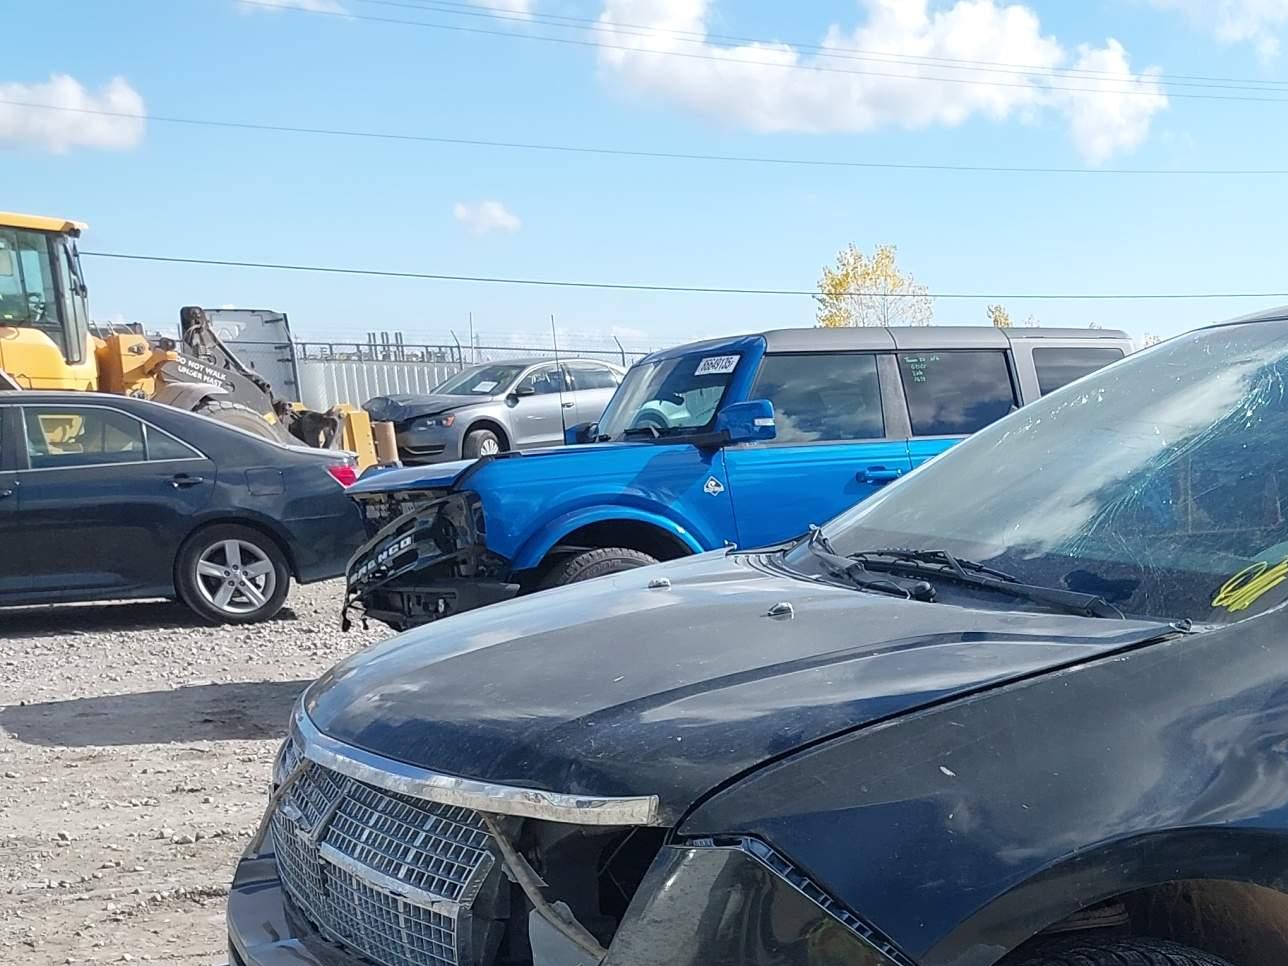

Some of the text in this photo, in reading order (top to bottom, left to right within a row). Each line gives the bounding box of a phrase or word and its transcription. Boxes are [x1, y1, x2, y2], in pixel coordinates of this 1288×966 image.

[176, 355, 227, 381] DO NOT WALK
[177, 365, 223, 388] UNDER MAST
